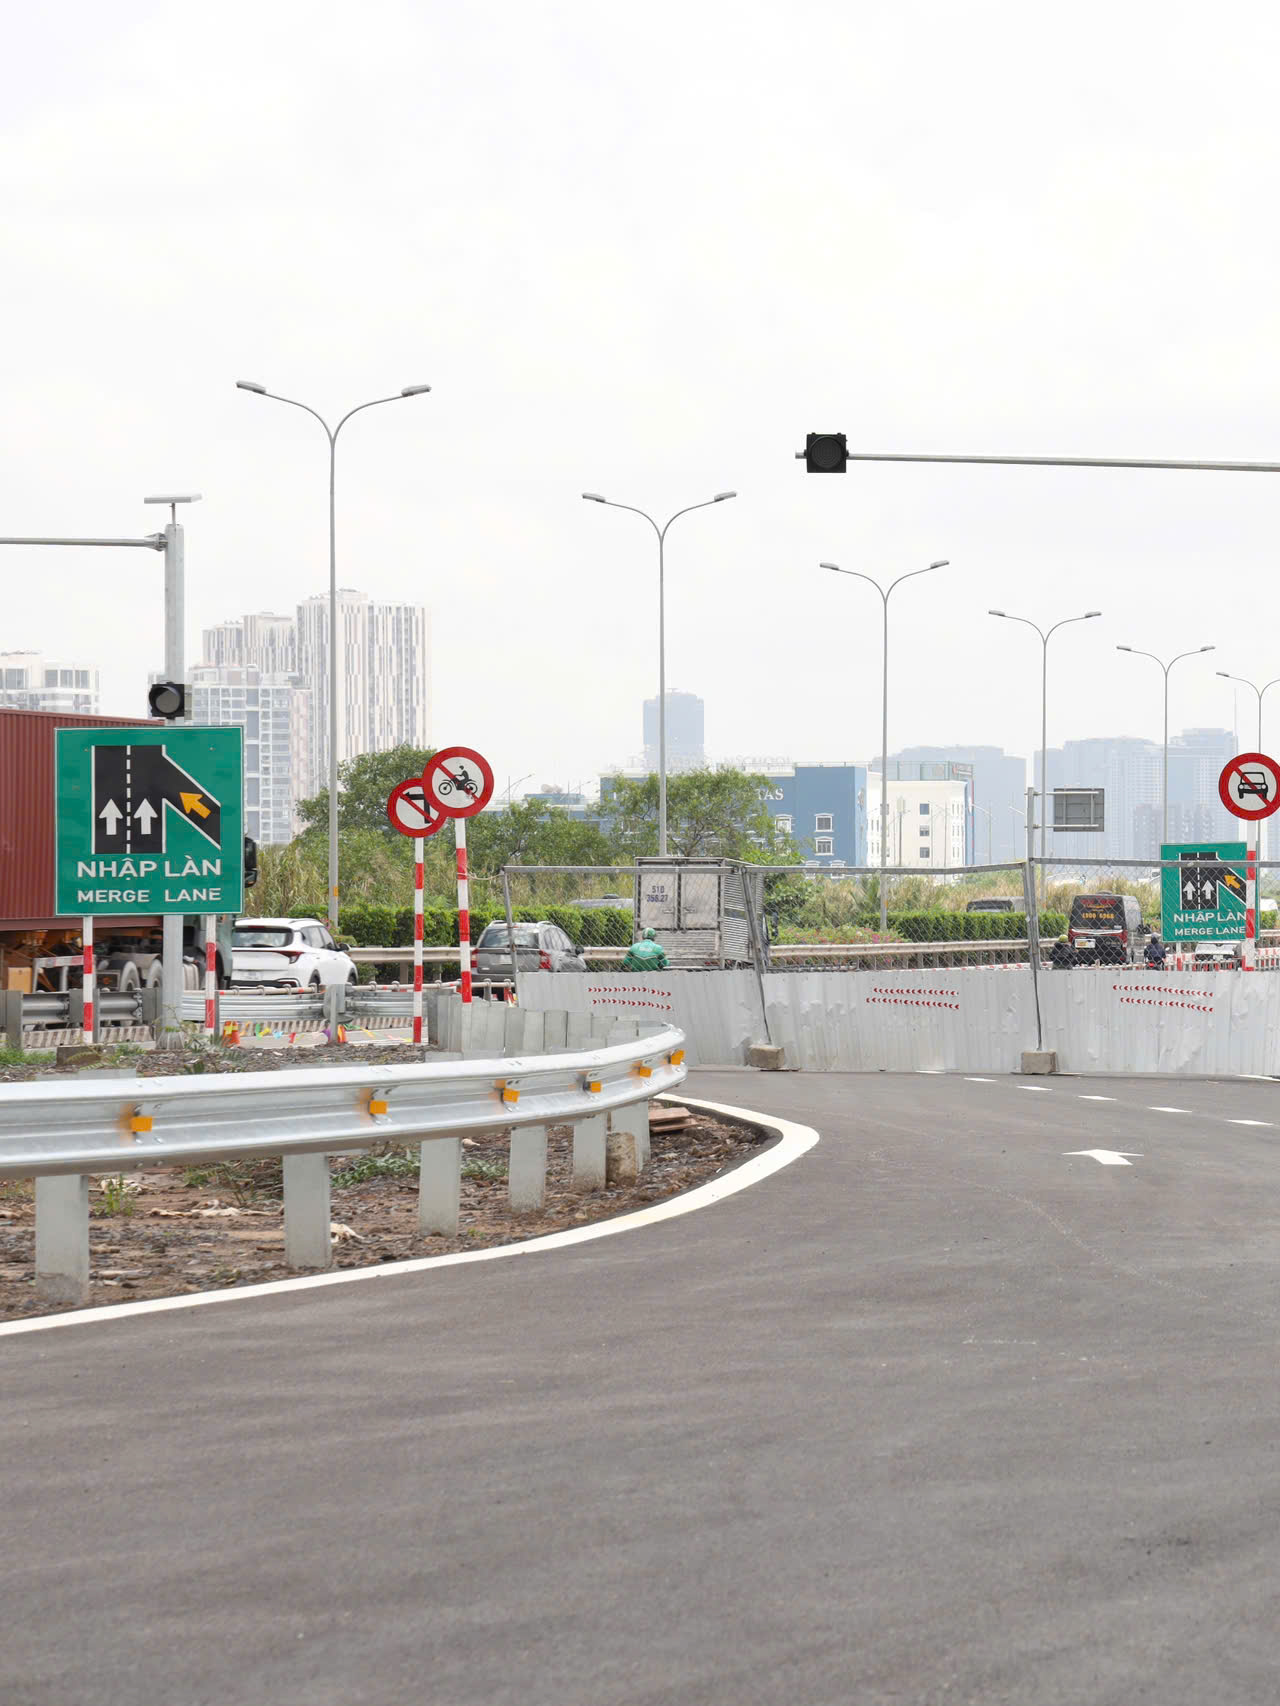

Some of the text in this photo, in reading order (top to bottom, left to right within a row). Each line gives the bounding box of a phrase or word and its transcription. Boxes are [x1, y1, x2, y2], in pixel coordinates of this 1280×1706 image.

[77, 854, 222, 881] NHẬP LÀN
[77, 887, 222, 904] MERGE LANE
[1173, 908, 1247, 924] NHẬP LÀN
[1174, 926, 1246, 936] MERGE LANE
